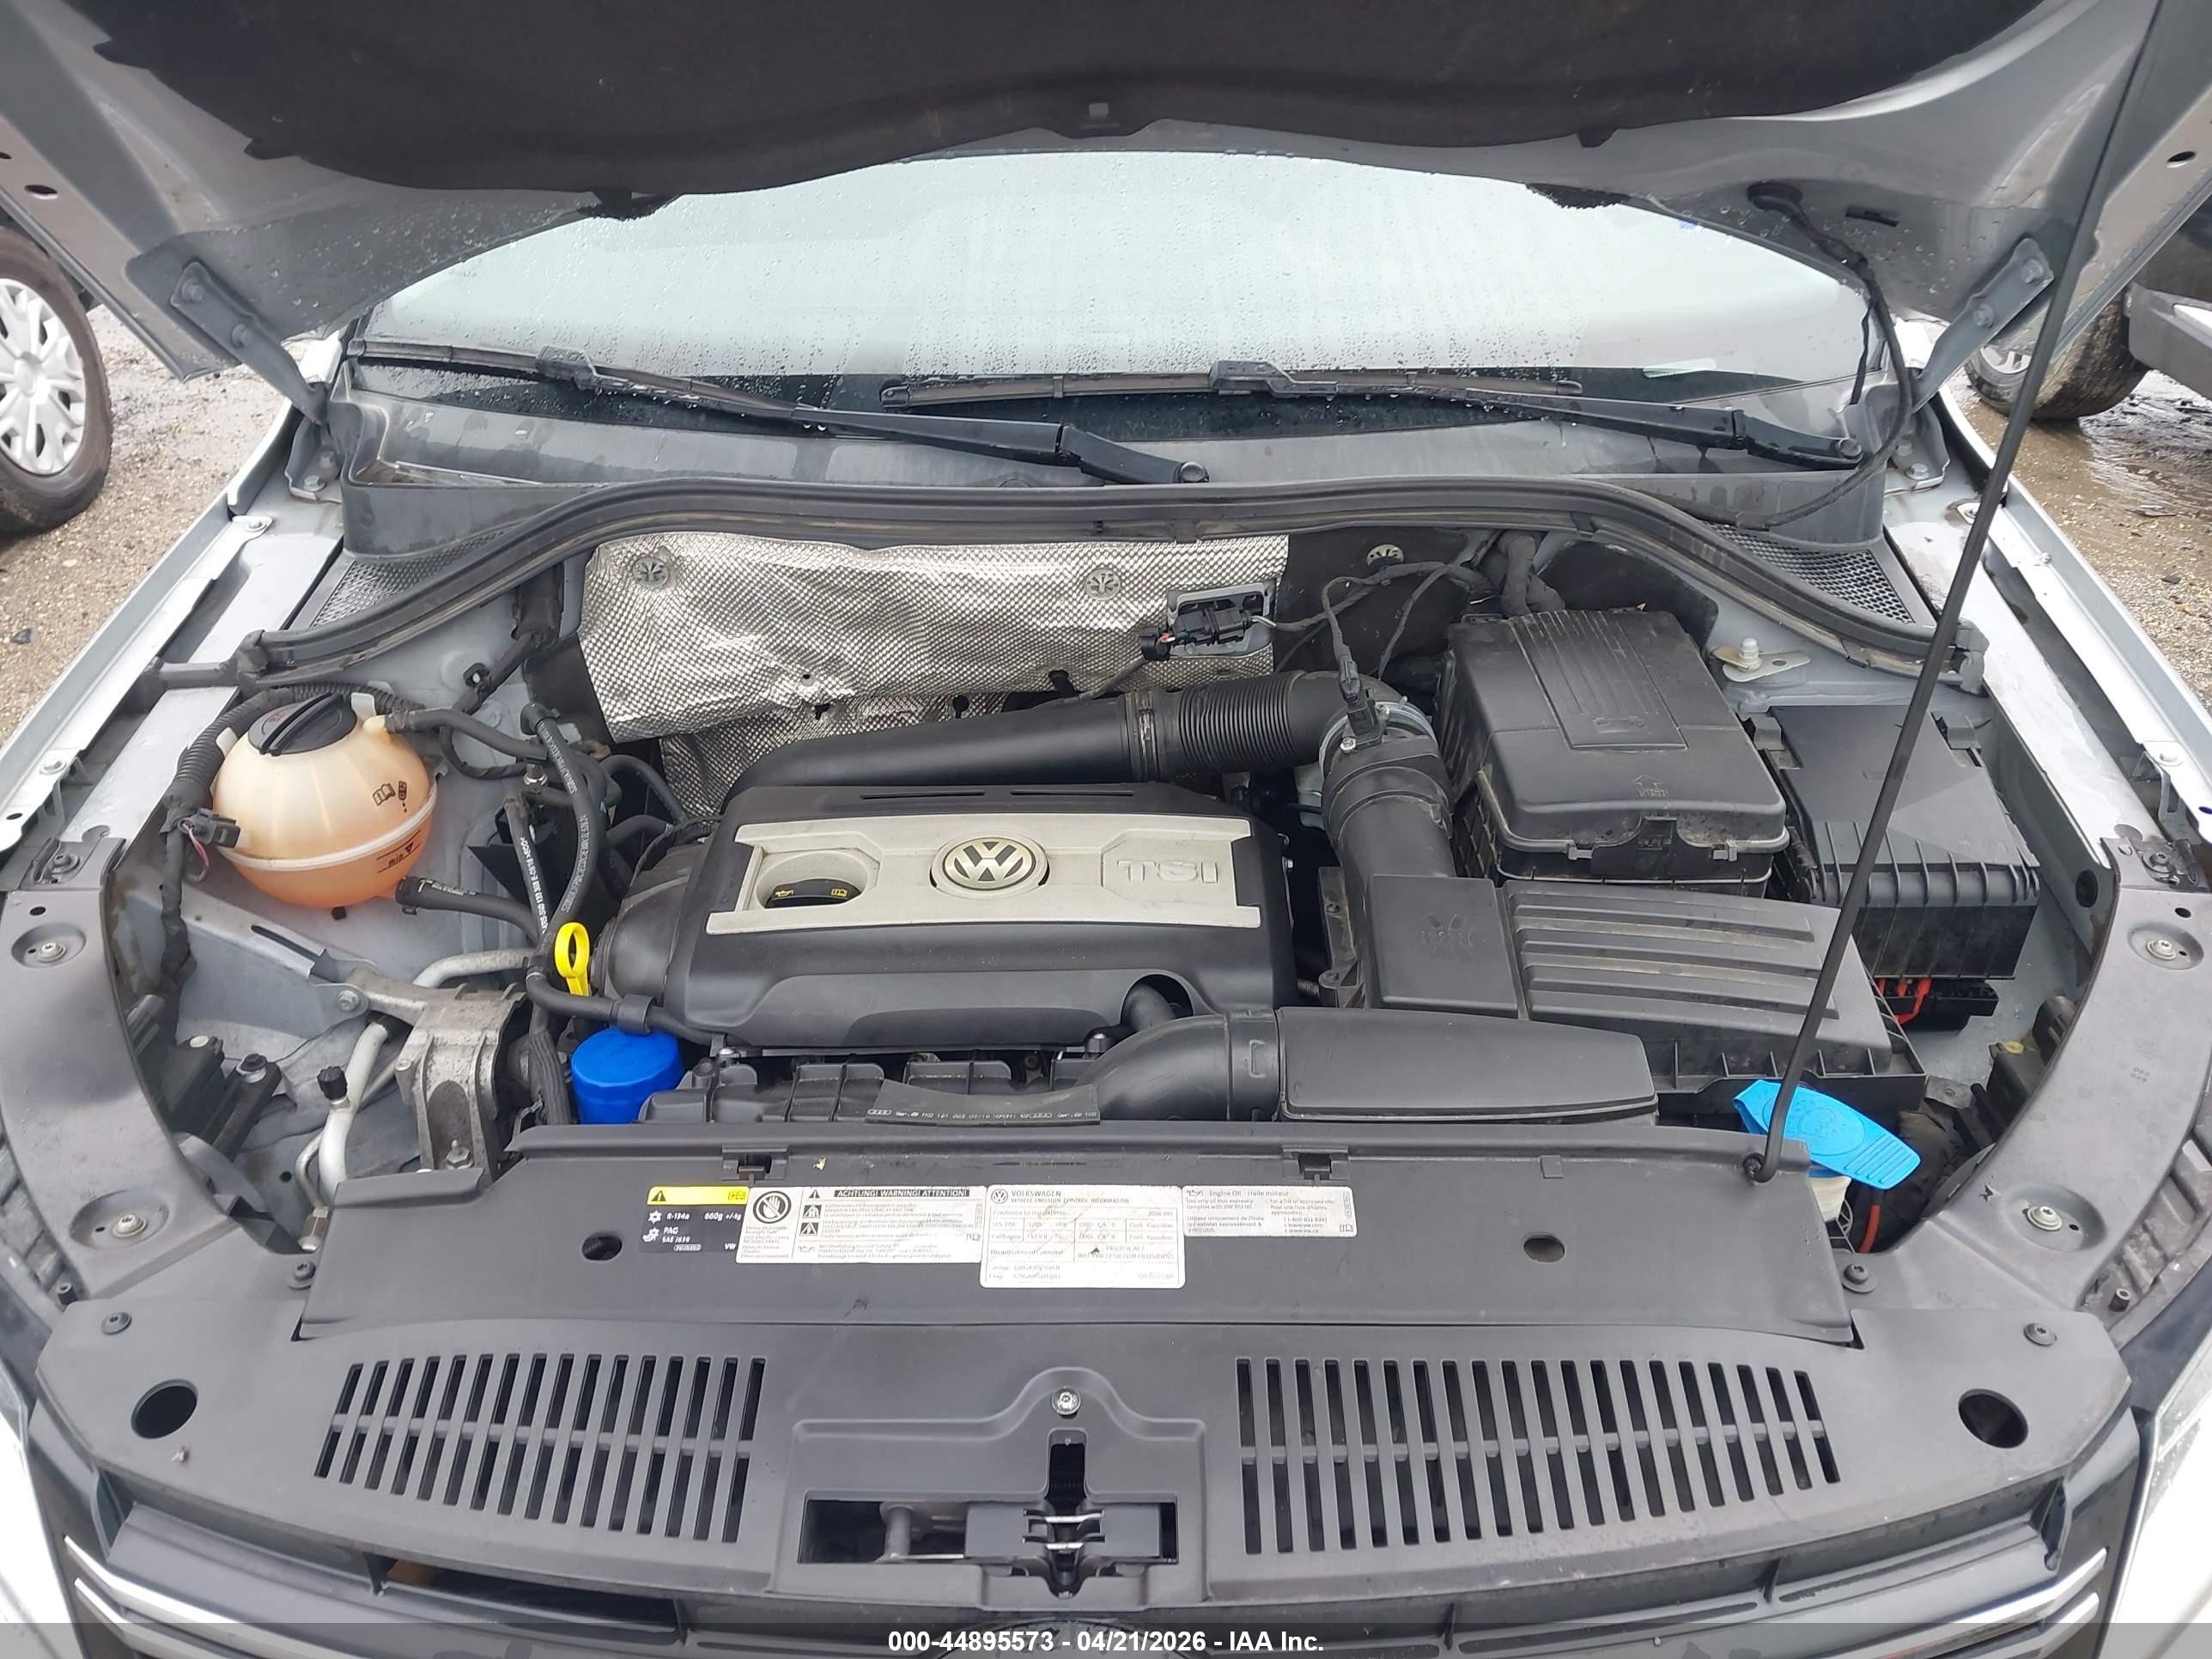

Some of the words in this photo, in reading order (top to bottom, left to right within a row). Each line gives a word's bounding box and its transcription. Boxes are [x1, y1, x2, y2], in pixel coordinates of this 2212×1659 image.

[388, 854, 404, 866] min
[1117, 860, 1218, 884] TSI
[663, 1226, 679, 1235] PAG
